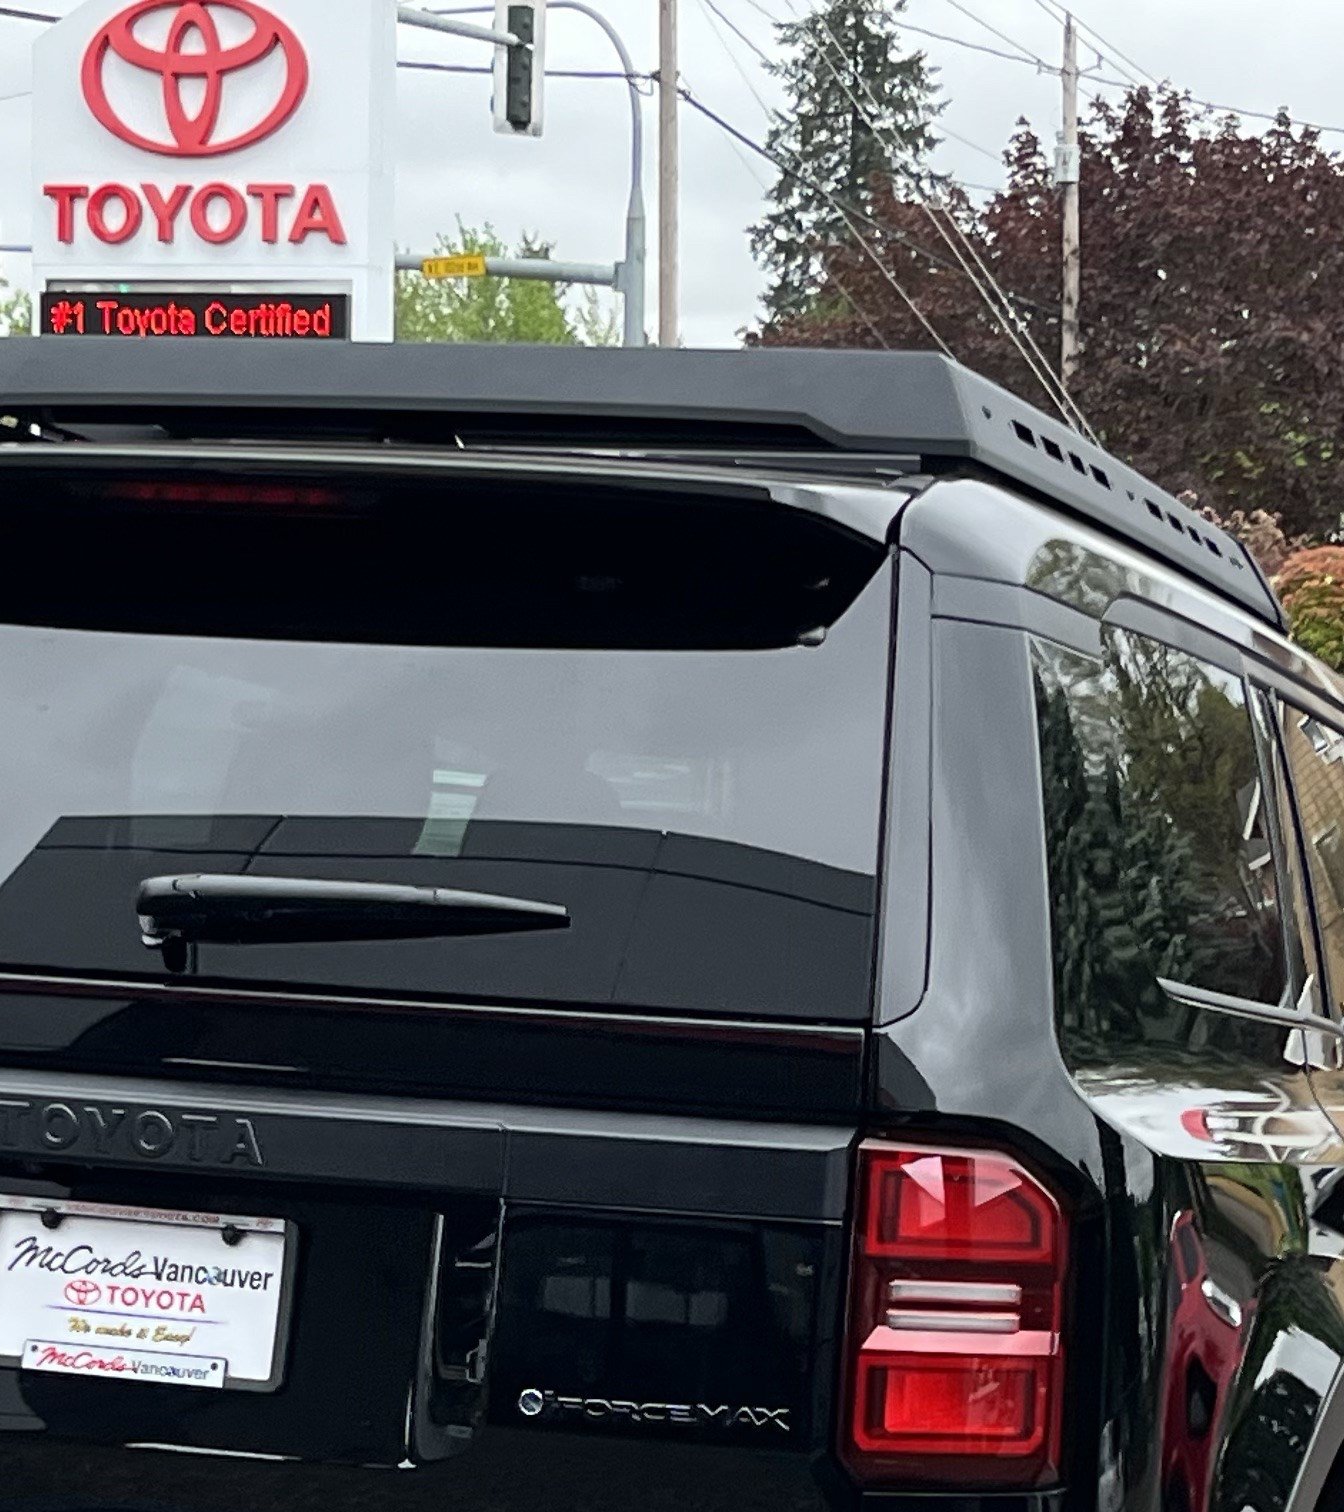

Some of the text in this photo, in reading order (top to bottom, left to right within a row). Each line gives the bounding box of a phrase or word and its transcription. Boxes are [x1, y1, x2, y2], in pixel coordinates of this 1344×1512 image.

[43, 182, 347, 244] TOYOTA
[50, 301, 331, 338] #1 Toyota Certified
[107, 1285, 206, 1313] TOYOTA
